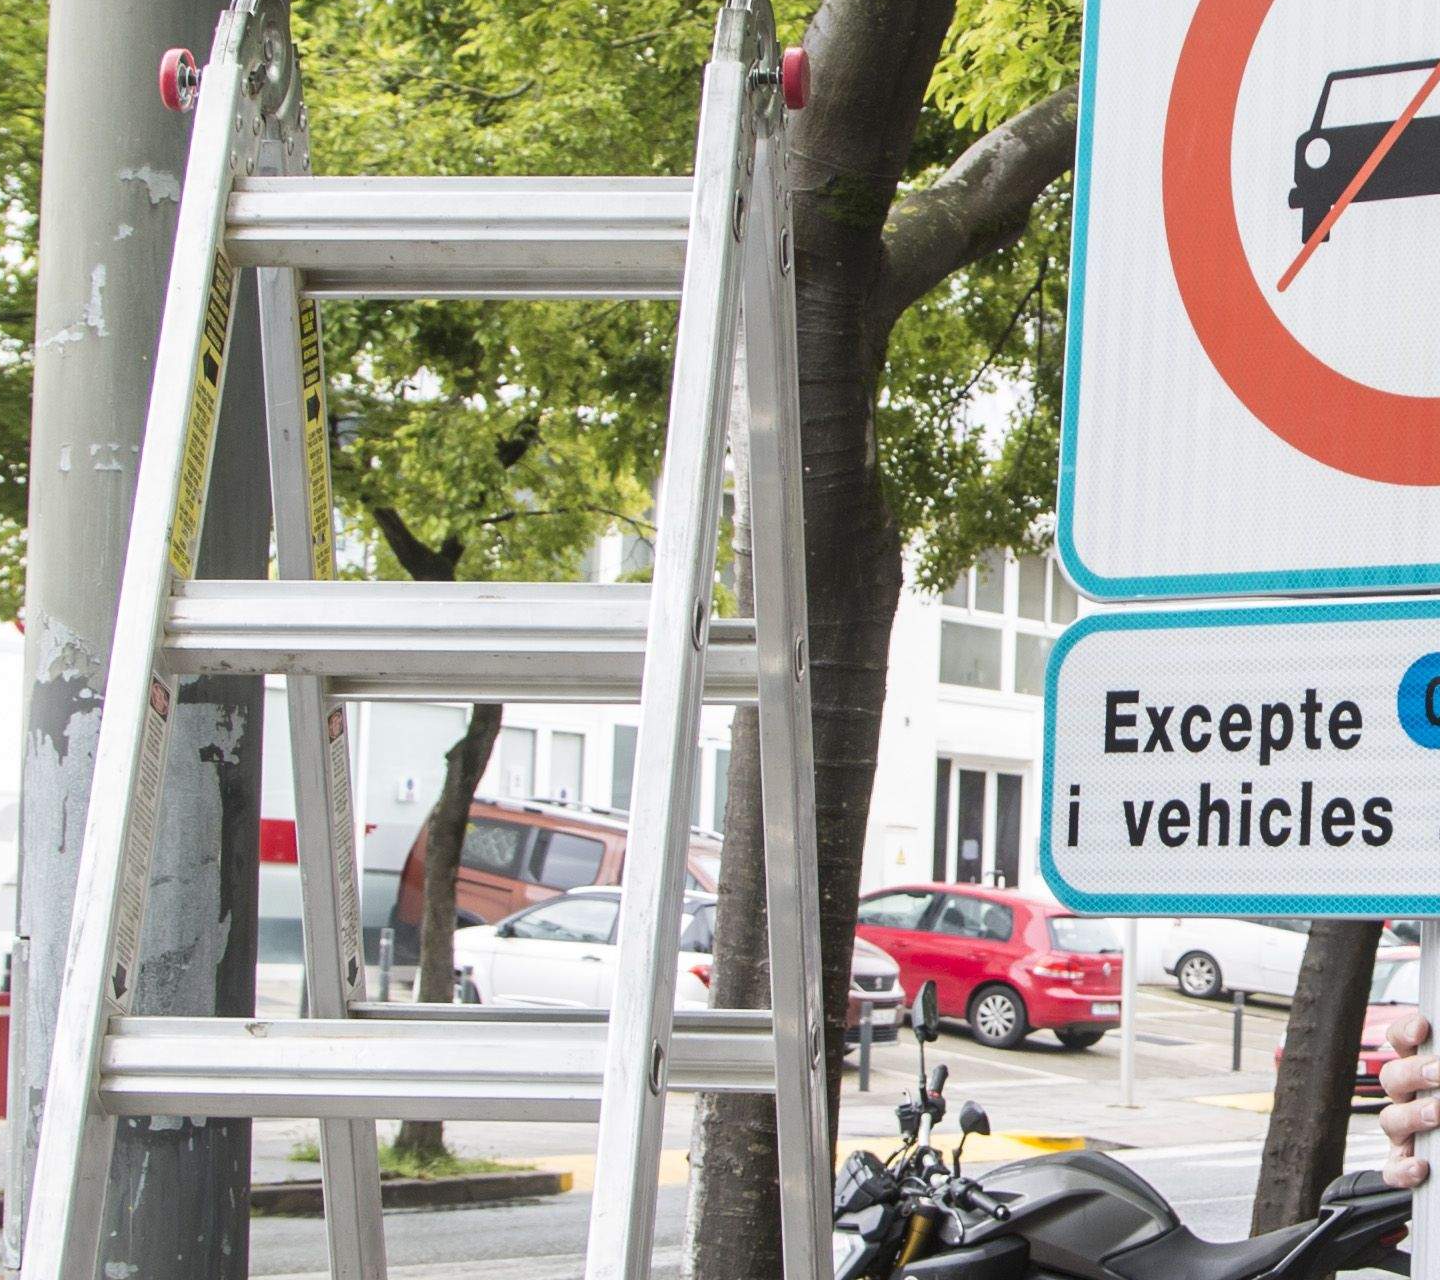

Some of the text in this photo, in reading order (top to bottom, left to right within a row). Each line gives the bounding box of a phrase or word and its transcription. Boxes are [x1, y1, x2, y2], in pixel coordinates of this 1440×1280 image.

[1102, 687, 1363, 766] Excepte
[1066, 785, 1081, 848] i
[1124, 782, 1394, 848] vehicles
